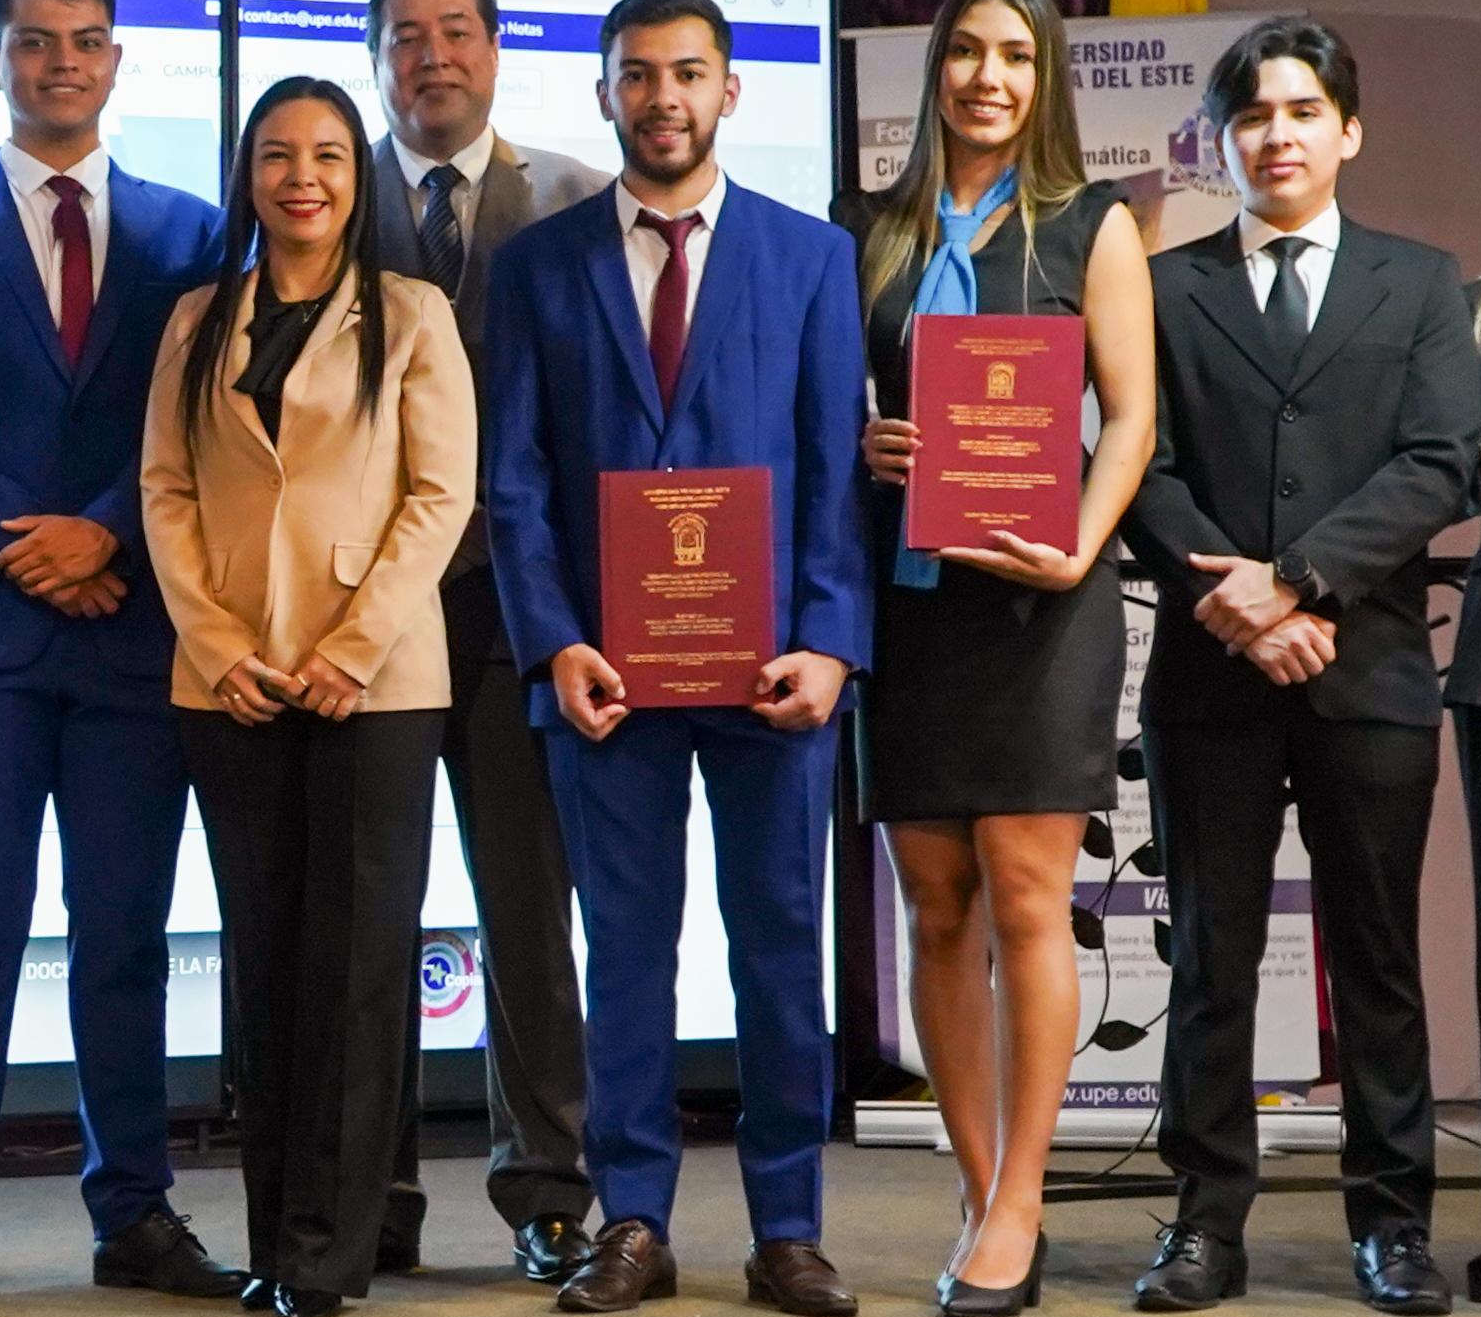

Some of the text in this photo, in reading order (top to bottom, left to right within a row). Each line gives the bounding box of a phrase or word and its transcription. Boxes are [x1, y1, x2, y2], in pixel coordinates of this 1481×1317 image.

[506, 23, 544, 38] Notas
[1092, 67, 1133, 90] DEL
[1141, 63, 1195, 87] ESTE
[179, 957, 202, 975] LA
